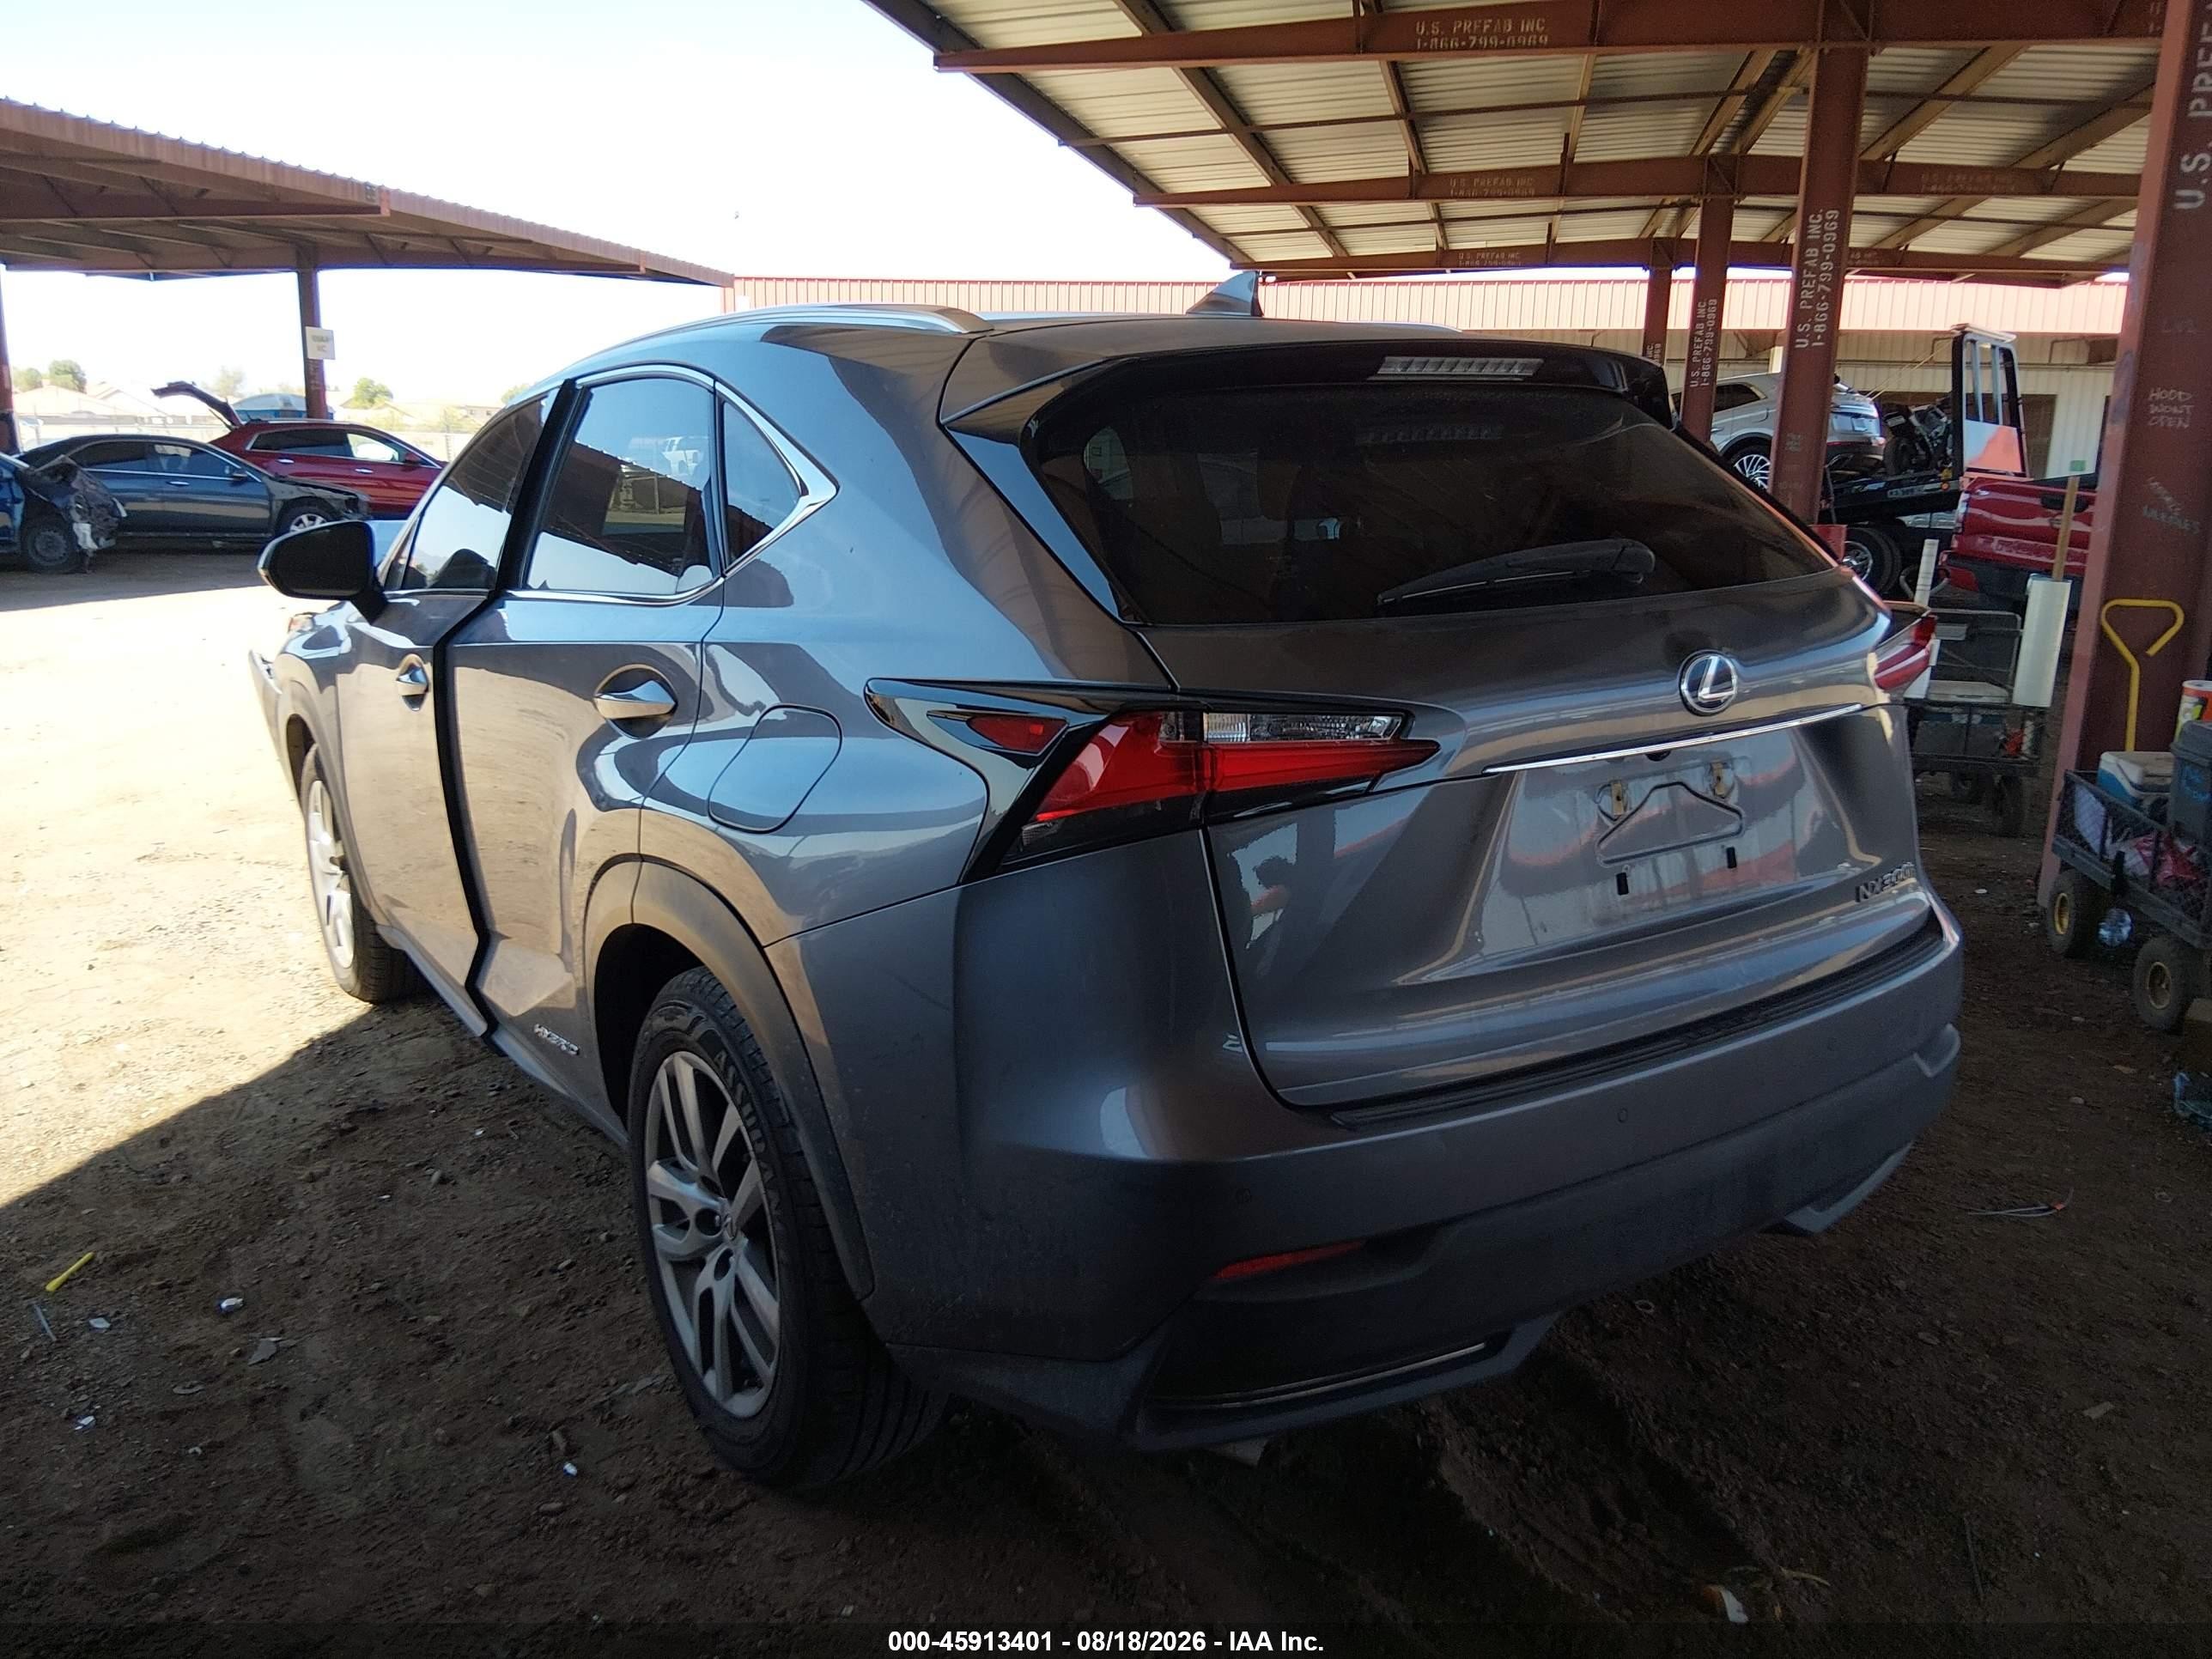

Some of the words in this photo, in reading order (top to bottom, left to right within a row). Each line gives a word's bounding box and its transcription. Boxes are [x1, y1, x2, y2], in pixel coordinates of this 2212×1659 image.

[1453, 18, 1513, 34] PREFAB
[1807, 208, 1823, 240] INC.
[1799, 247, 1820, 310] PREFAB
[1812, 210, 1839, 347] 1-866-799-0969
[1692, 323, 1705, 364] PREFAB
[1795, 317, 1812, 349] U.S.
[2148, 386, 2192, 402] HOOD
